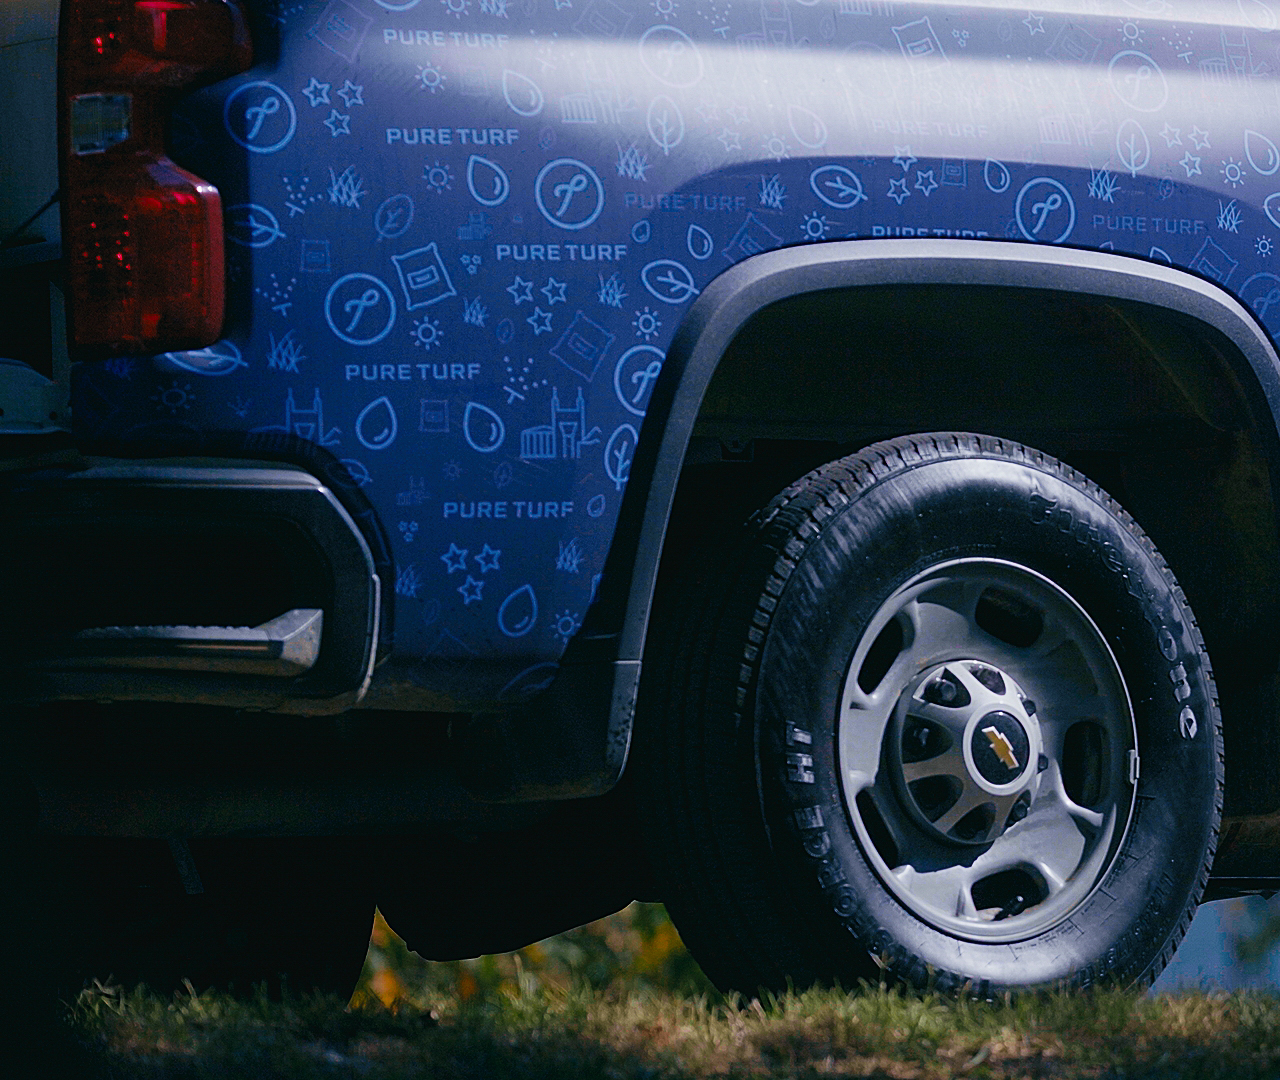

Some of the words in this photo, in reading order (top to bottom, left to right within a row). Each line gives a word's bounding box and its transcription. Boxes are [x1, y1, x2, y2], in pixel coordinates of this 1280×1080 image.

[383, 29, 446, 47] PURE
[449, 31, 510, 48] TURF
[386, 128, 450, 145] PURE
[456, 128, 519, 145] TURF
[1093, 214, 1148, 233] PURE
[1152, 218, 1205, 235] TURF
[496, 244, 560, 261] PURE
[564, 245, 627, 261] TURF
[345, 363, 411, 381] PURE
[416, 363, 481, 381] TURF
[443, 501, 508, 518] PURE
[512, 501, 575, 518] TURF
[786, 720, 815, 784] HT
